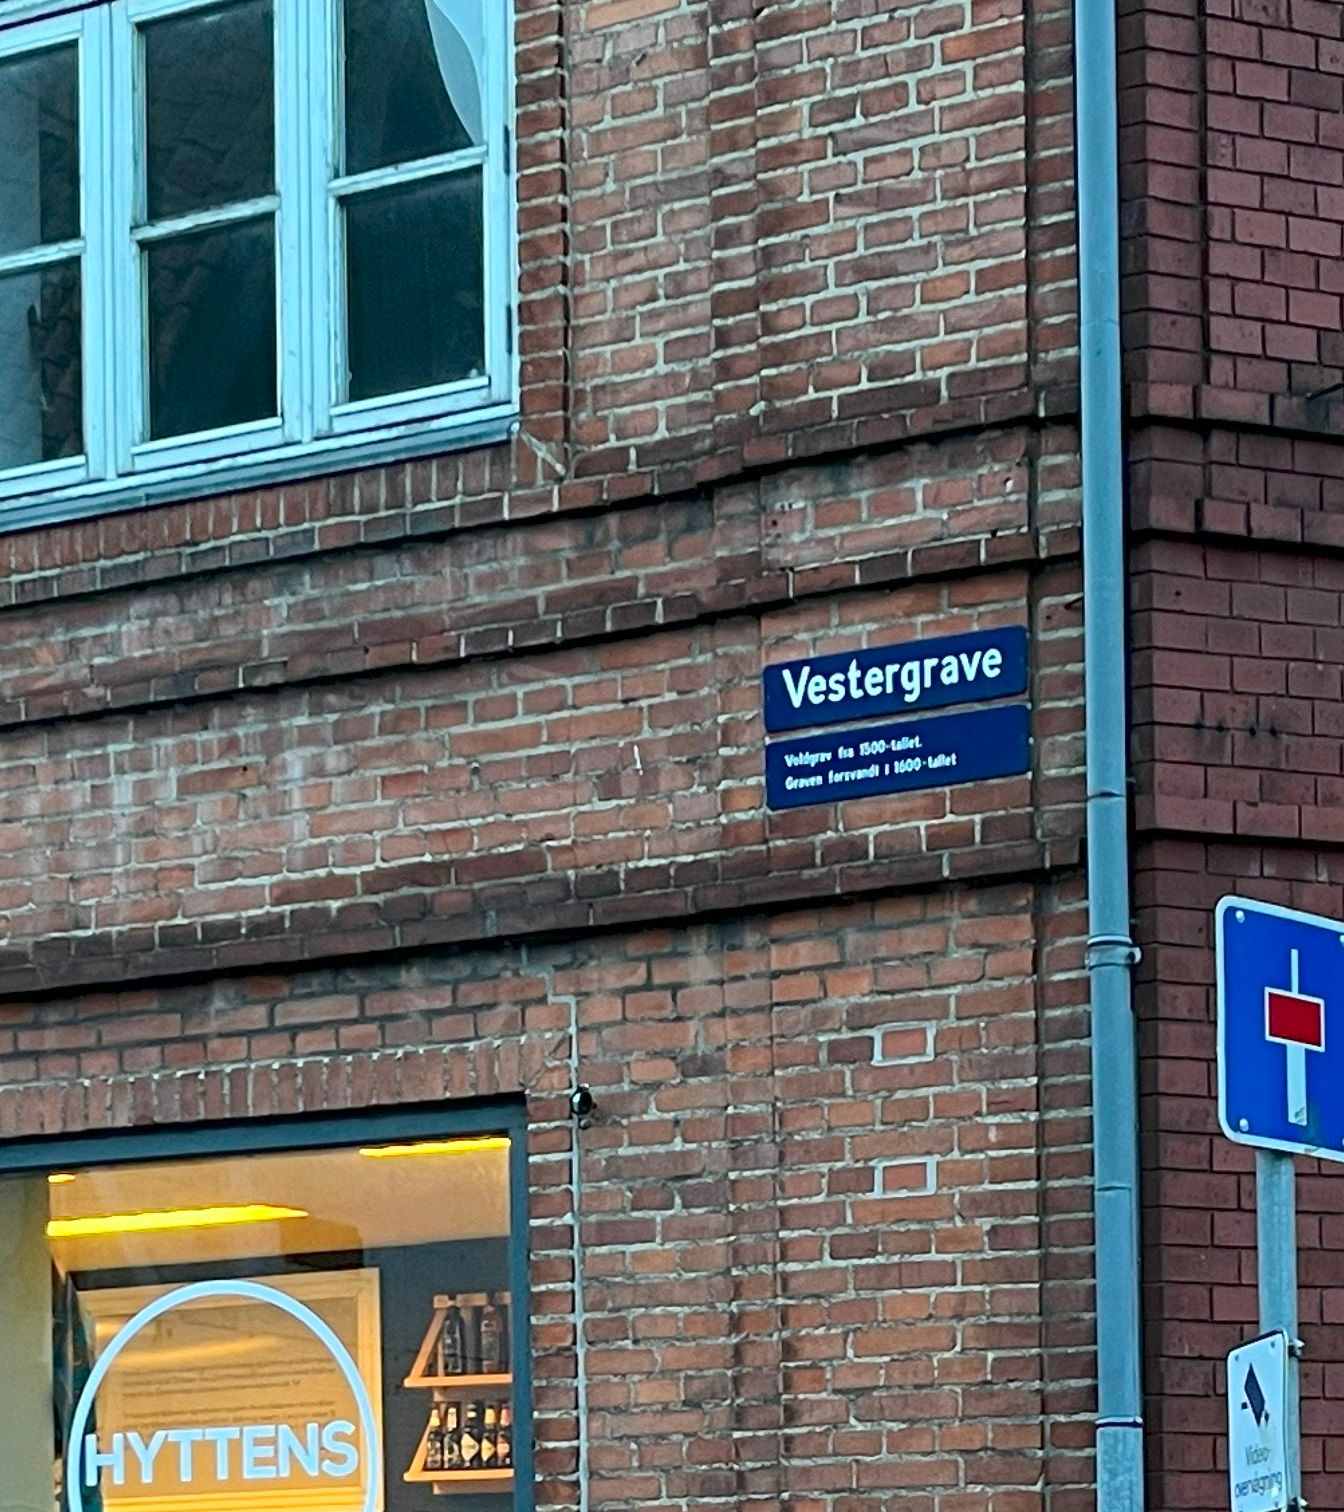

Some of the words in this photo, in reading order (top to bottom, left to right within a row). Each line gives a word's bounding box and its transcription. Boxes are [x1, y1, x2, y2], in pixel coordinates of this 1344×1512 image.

[782, 648, 1003, 709] Vestergrave
[837, 746, 855, 759] fra
[784, 775, 823, 791] Graven
[85, 1418, 358, 1487] HYTTENS
